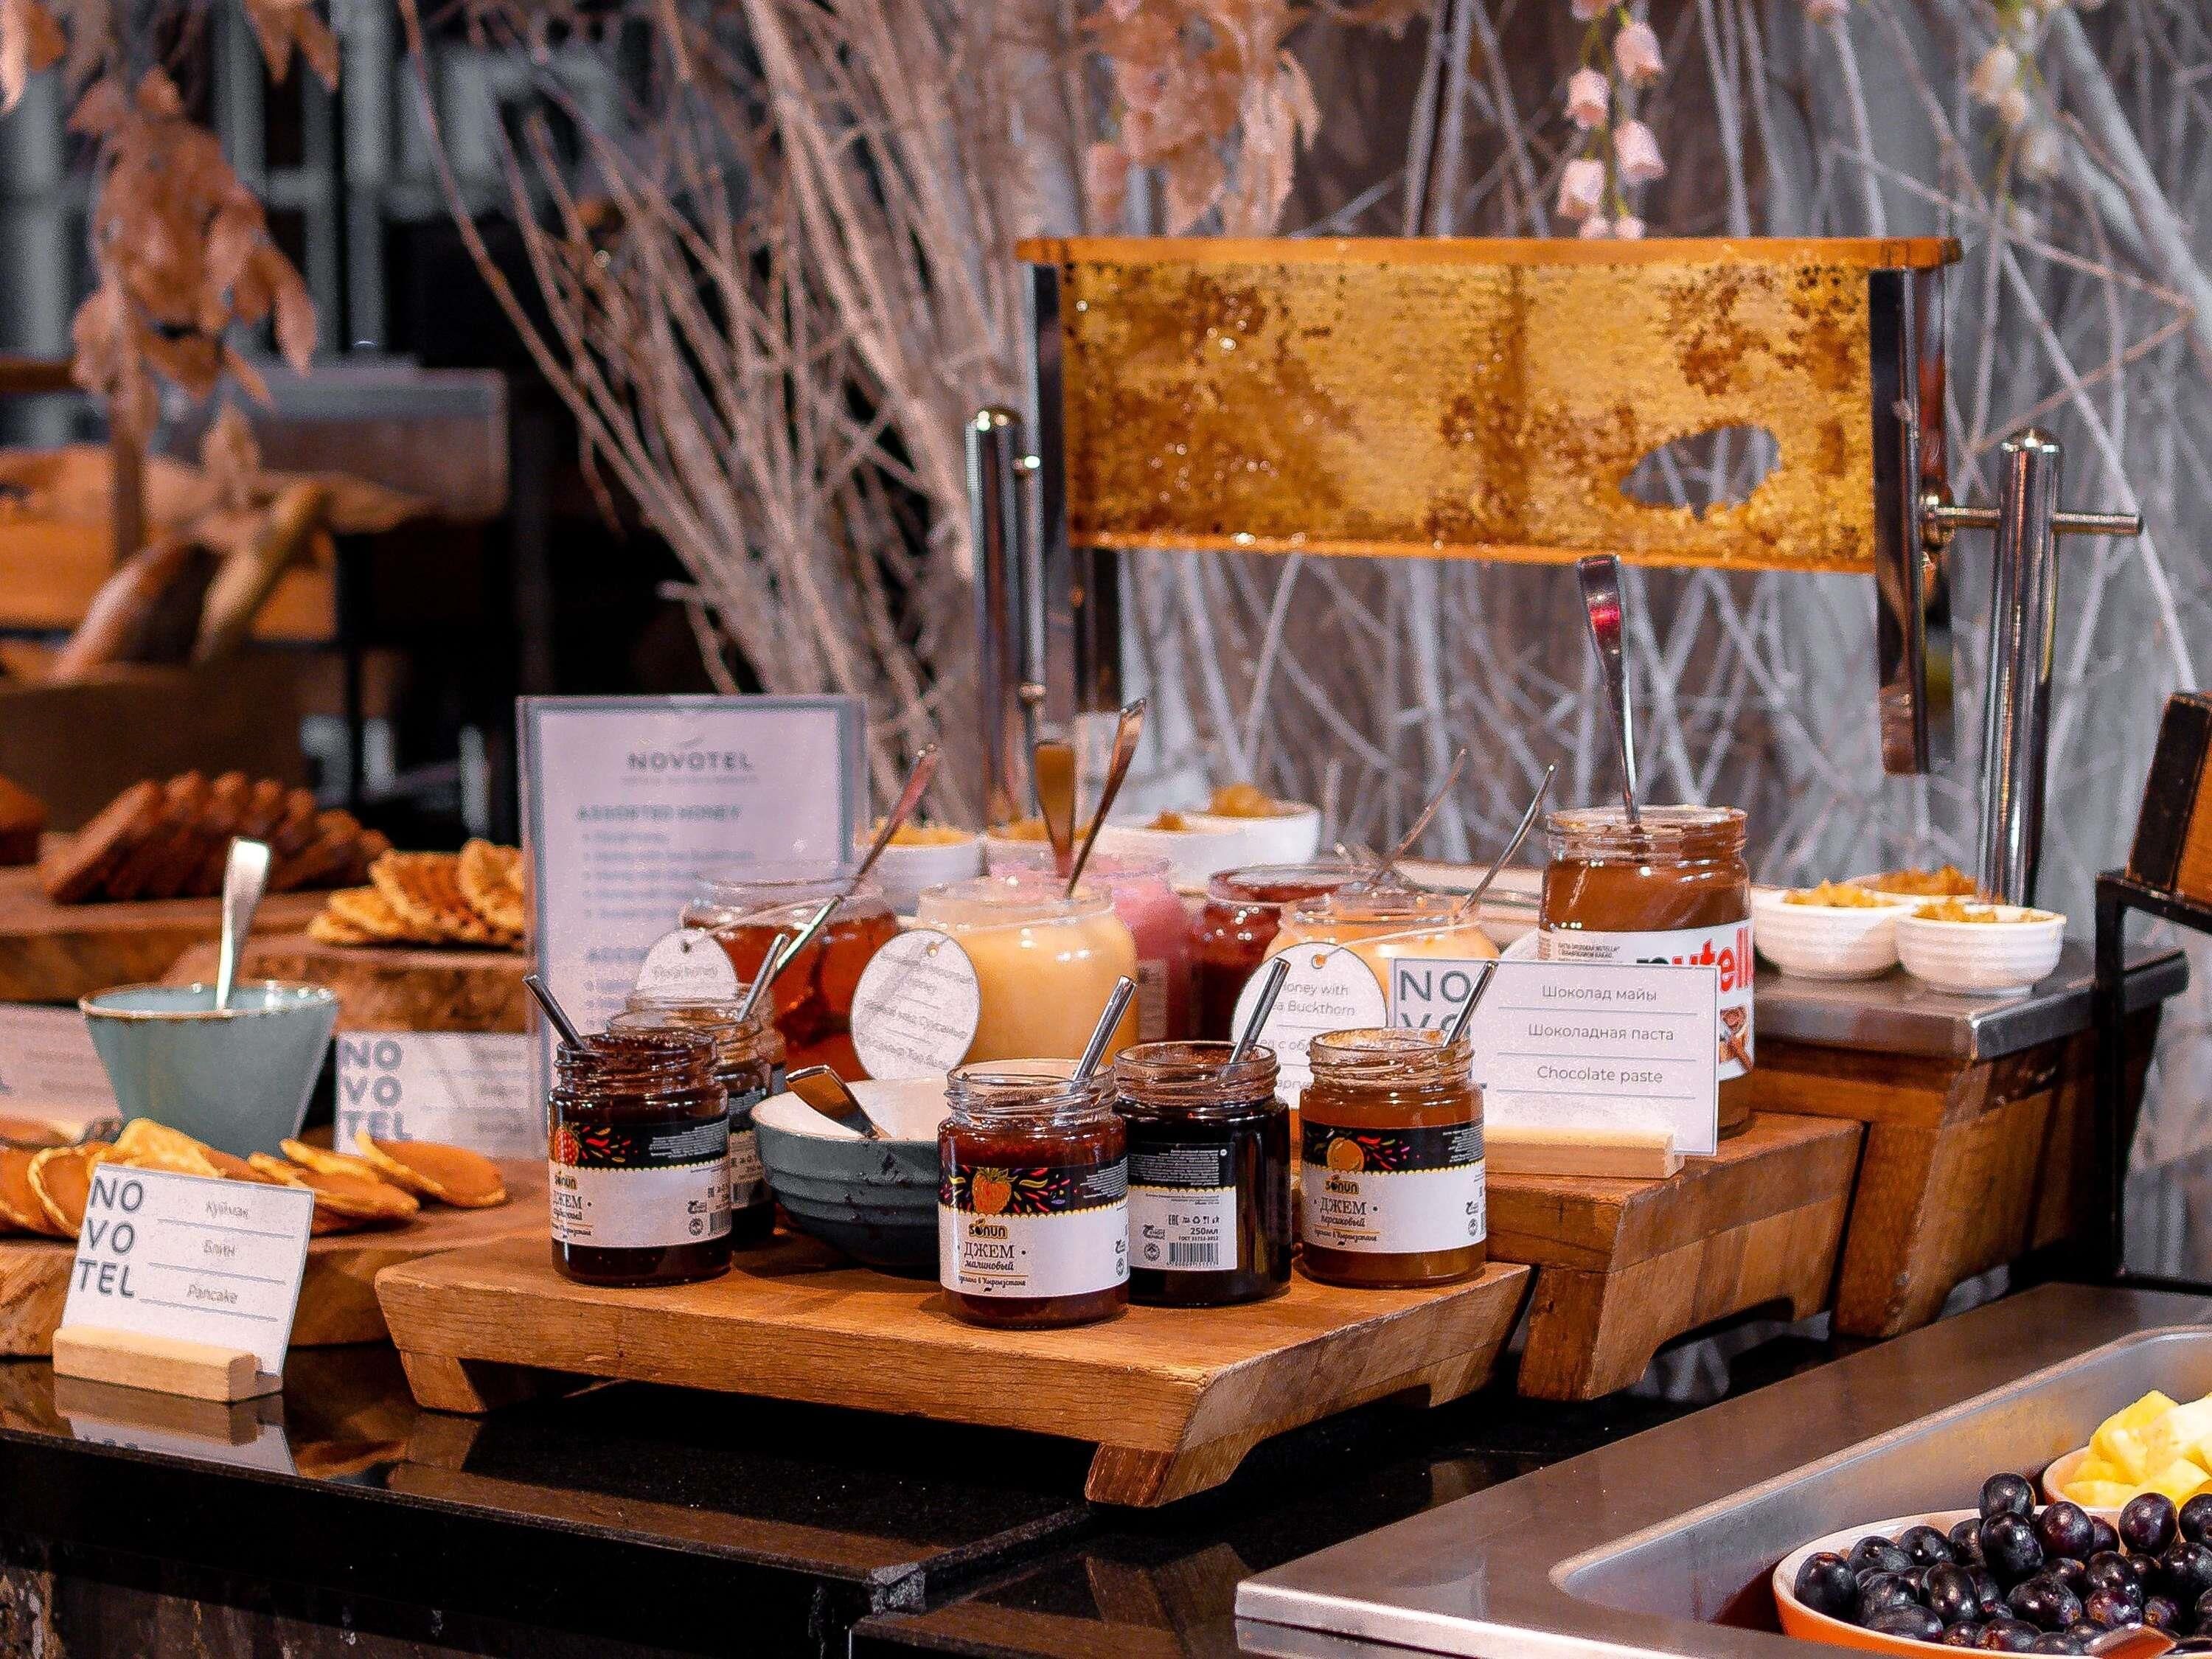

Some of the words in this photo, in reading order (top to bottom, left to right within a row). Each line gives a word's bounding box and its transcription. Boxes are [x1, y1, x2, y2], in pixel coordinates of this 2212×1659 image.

[627, 751, 753, 771] NOVOTEL
[1321, 983, 1349, 996] with
[1401, 970, 1471, 1003] NO
[1542, 985, 1612, 1002] Шоколад
[1616, 989, 1658, 1001] майы
[1287, 1000, 1355, 1016] Buckthorn
[1528, 1023, 1627, 1040] Шоколадная
[1631, 1029, 1674, 1041] паста
[339, 1039, 403, 1070] NO
[1537, 1065, 1615, 1082] Chocolate
[1620, 1069, 1663, 1085] paste
[344, 1076, 403, 1107] VO
[90, 1175, 143, 1213] NO
[1320, 1197, 1367, 1215] ДЖЕМ
[86, 1217, 136, 1255] VO
[1190, 1227, 1219, 1235] 250мл
[964, 1241, 1015, 1259] ДЖЕМ
[964, 1259, 1015, 1271] малиновый
[77, 1258, 135, 1298] TEL
[187, 1283, 238, 1304] Pancake
